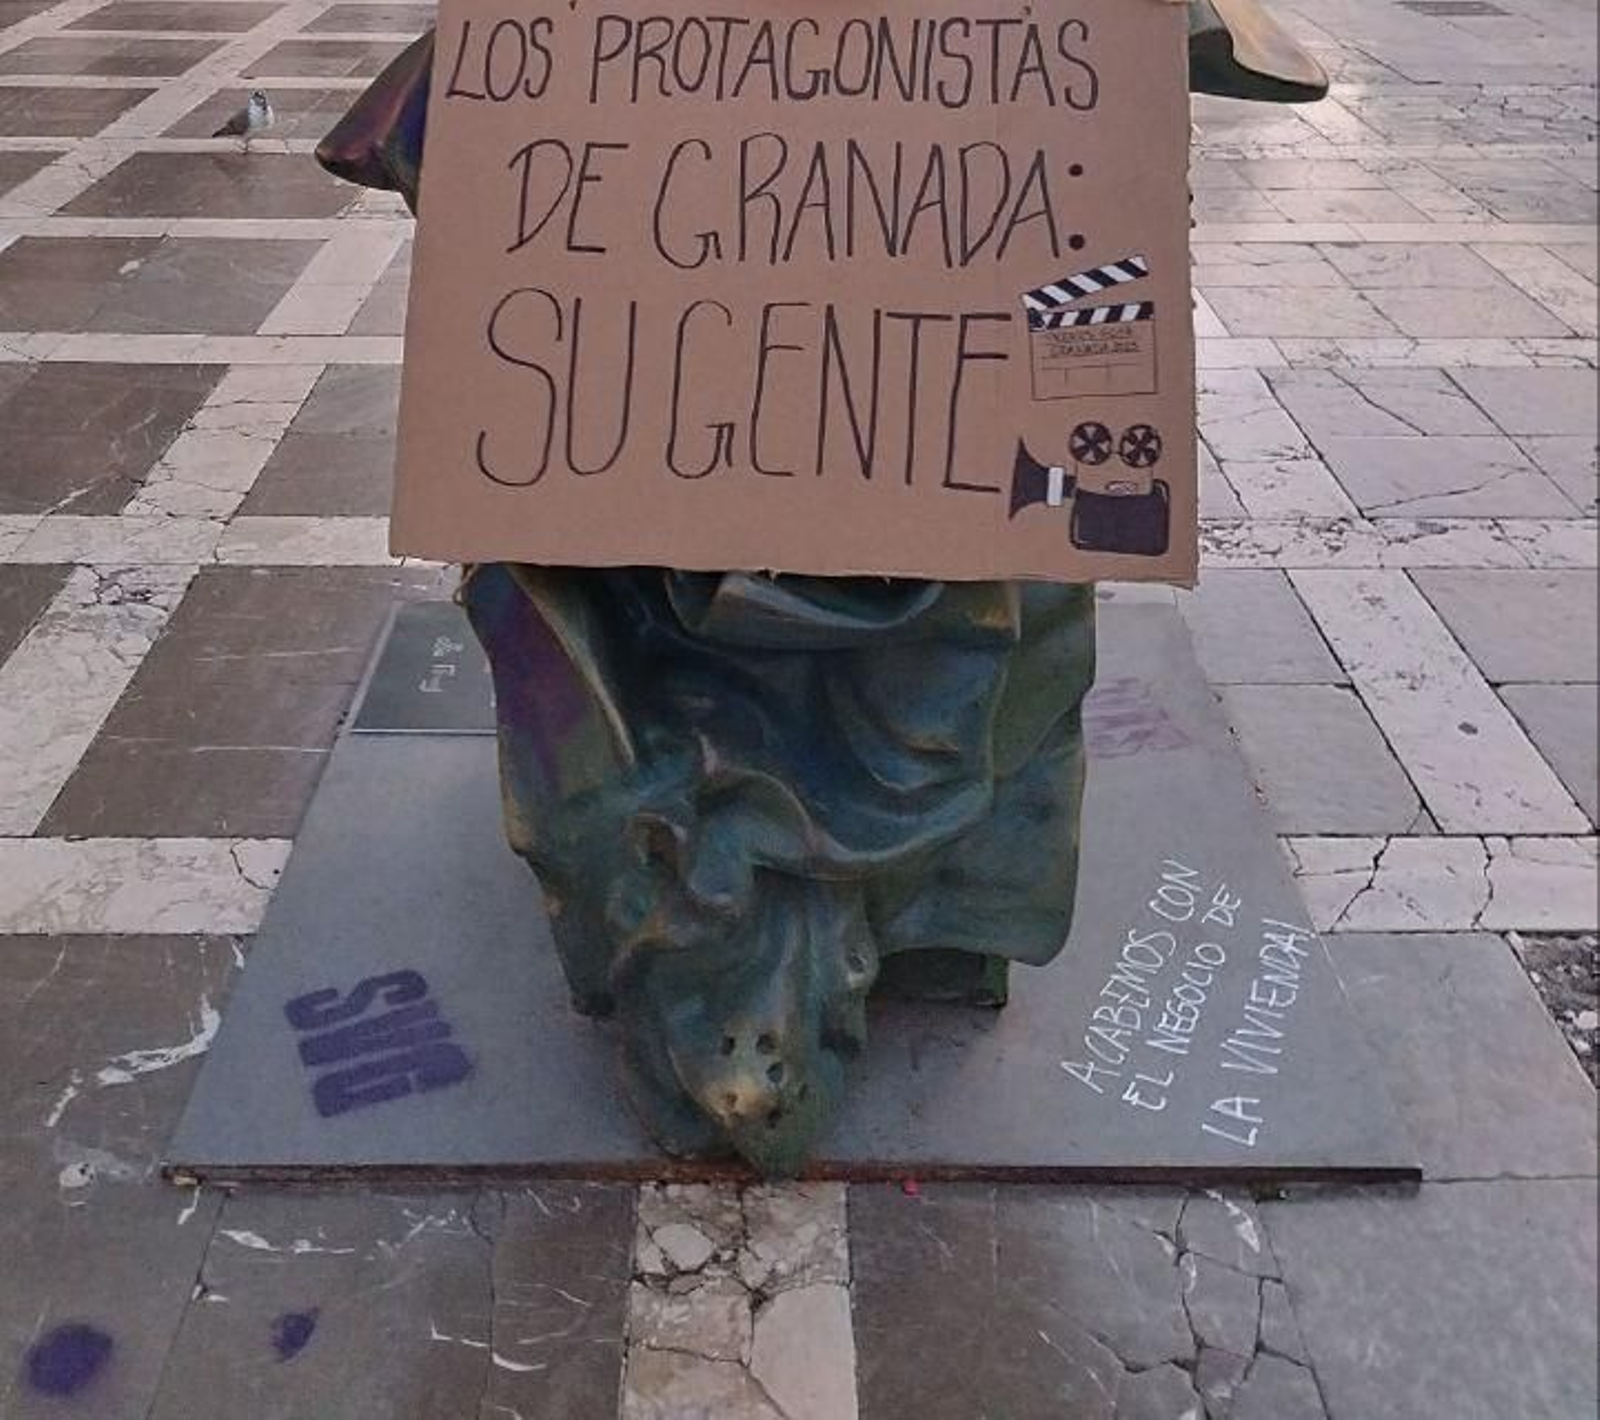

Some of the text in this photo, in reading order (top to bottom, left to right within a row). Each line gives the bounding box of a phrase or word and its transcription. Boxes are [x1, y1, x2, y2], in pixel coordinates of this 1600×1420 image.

[444, 13, 1100, 111] LOS PROTAGONISTAS
[506, 130, 1086, 270] DE GRANADA:
[476, 286, 1012, 493] SU GENTE
[1060, 858, 1202, 1095] ACABEMOS CON
[1121, 883, 1242, 1111] EL NEGOCIO DE
[1201, 917, 1317, 1147] LA VIVIENDA!
